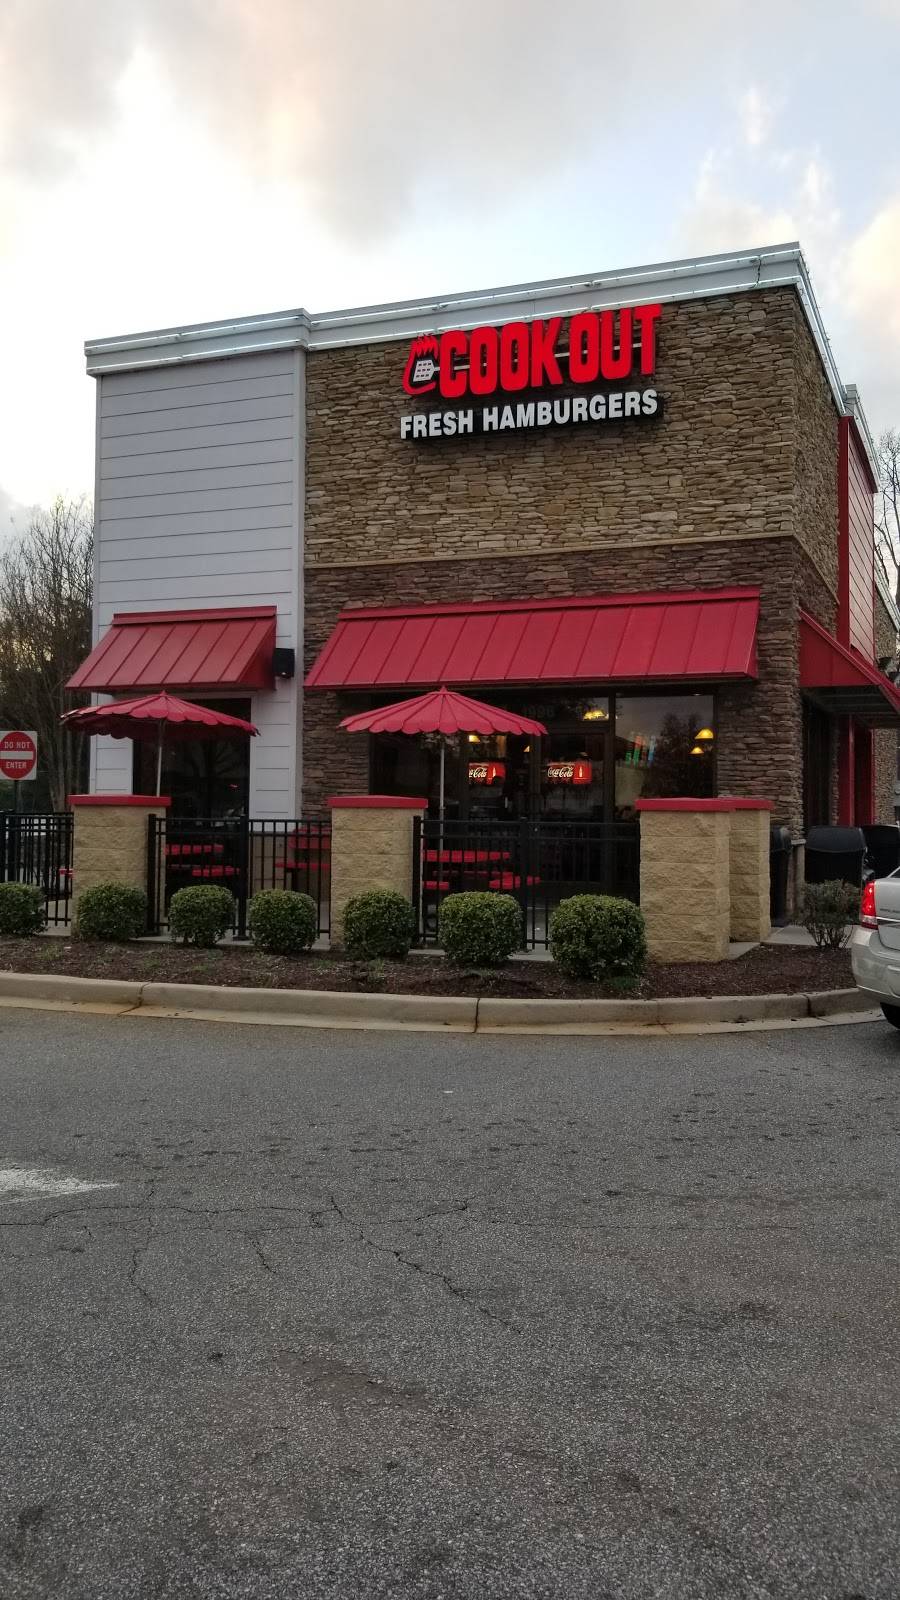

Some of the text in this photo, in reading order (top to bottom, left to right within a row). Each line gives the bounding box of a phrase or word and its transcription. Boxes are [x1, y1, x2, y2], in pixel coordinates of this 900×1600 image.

[439, 303, 663, 398] COOK OUT
[400, 389, 659, 440] FRESH HAMBURGERS
[4, 741, 31, 749] DO NOT
[5, 761, 27, 769] ENTER
